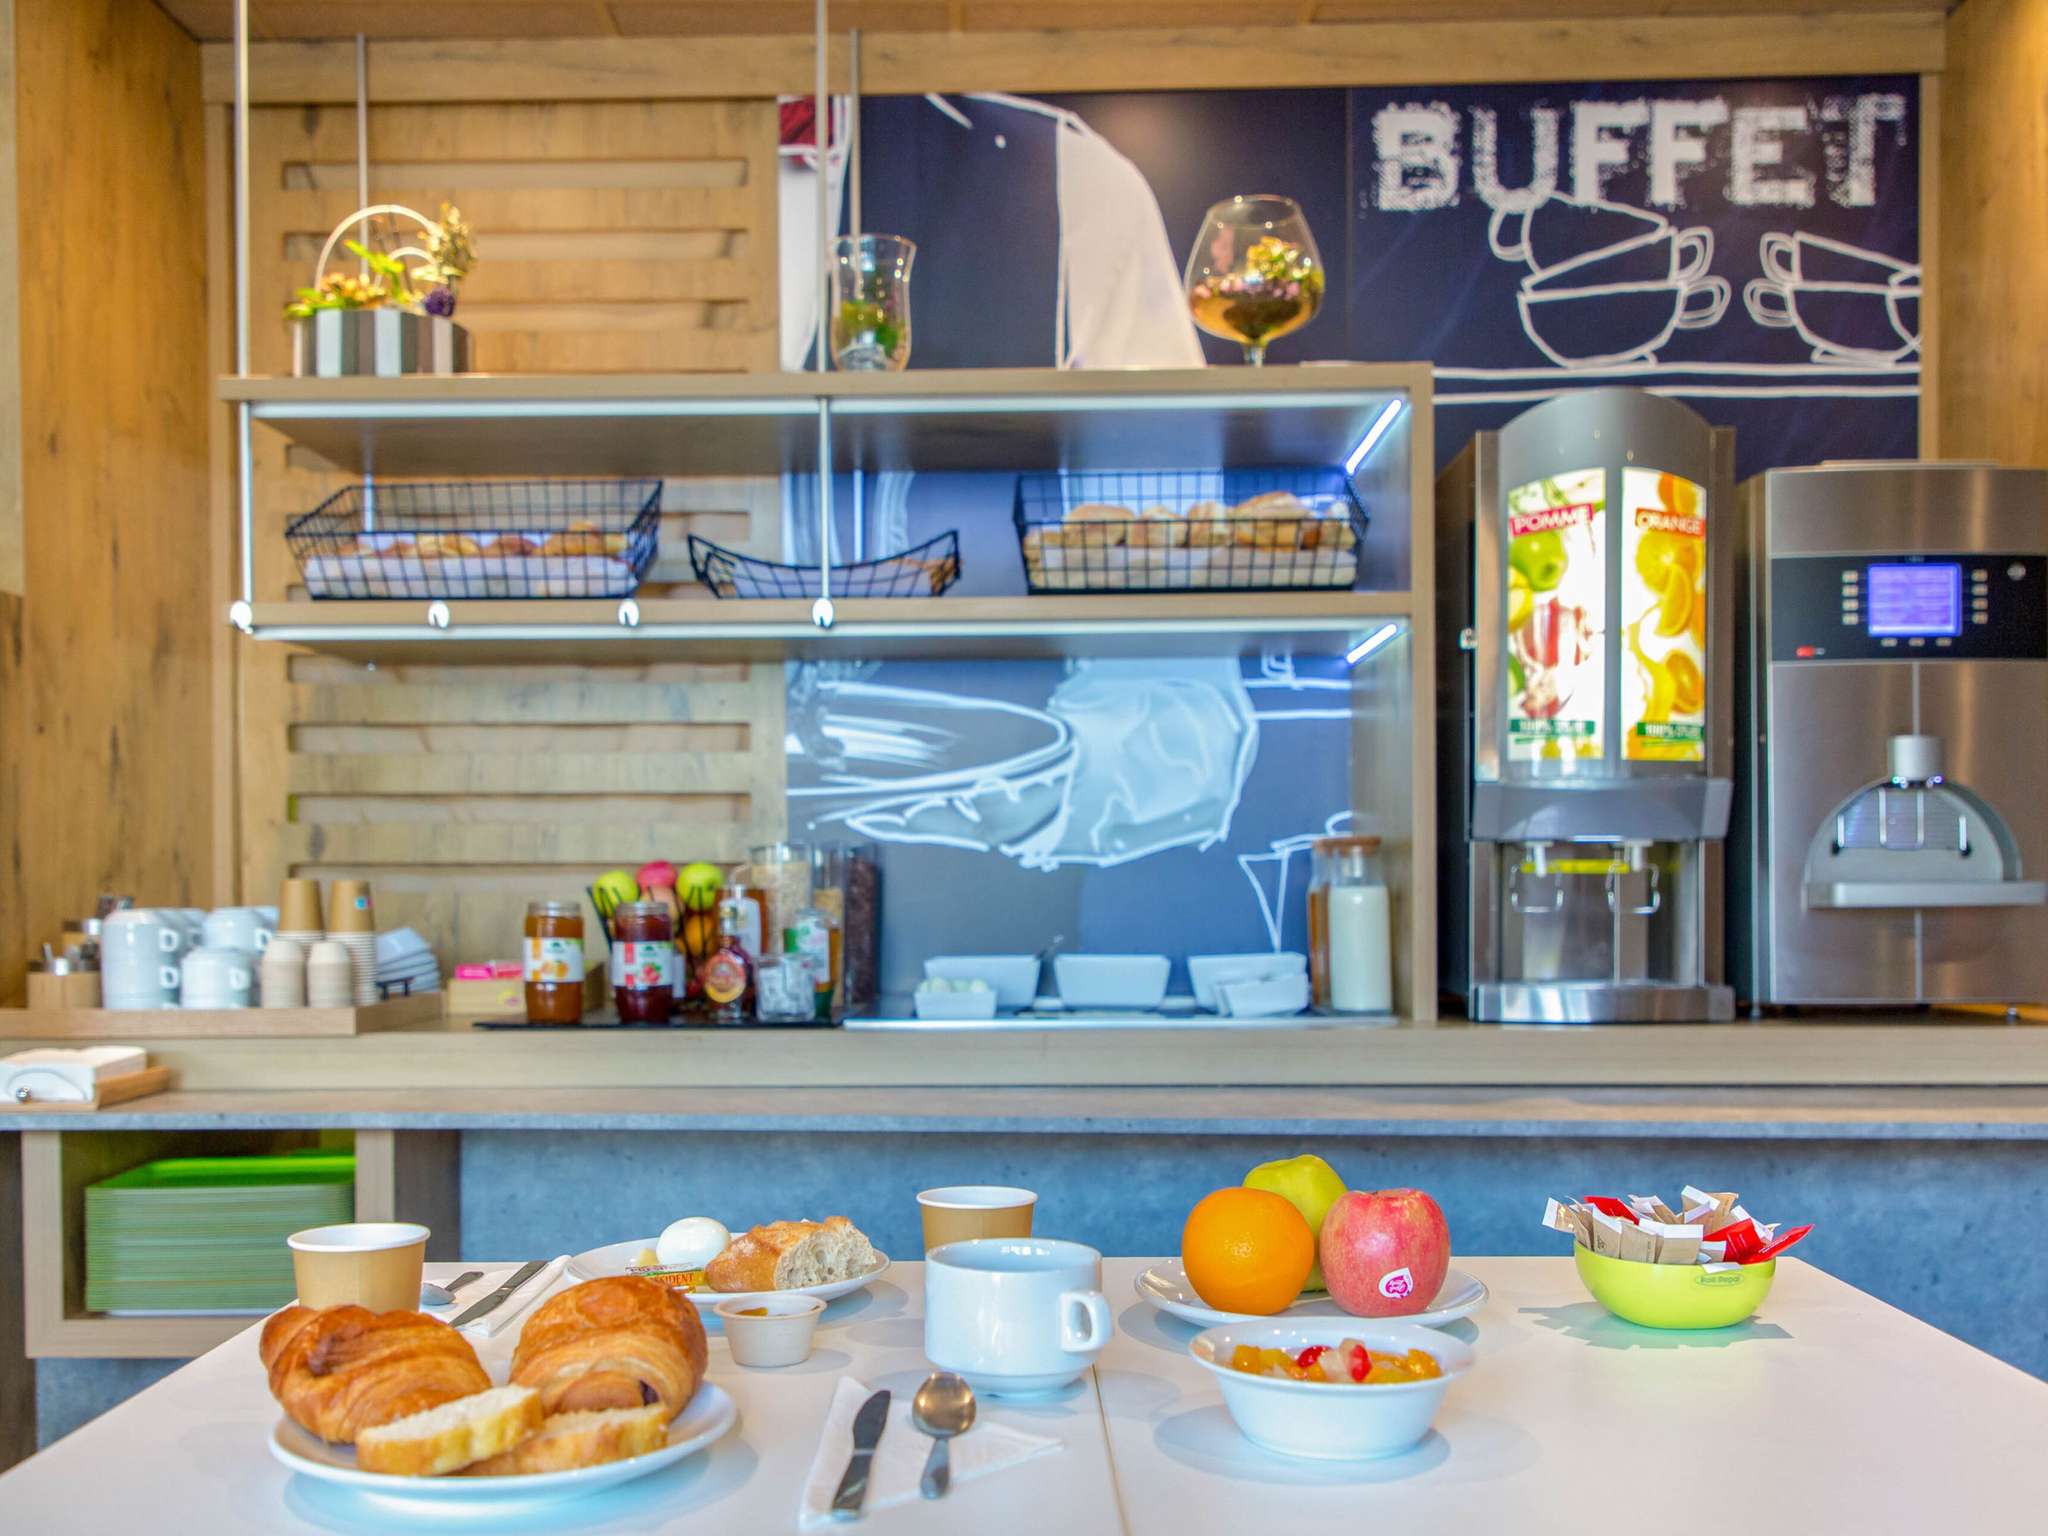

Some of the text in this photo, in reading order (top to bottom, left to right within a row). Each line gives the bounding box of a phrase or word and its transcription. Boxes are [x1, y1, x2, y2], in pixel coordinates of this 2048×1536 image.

[1372, 94, 1907, 211] BUFFET
[1512, 506, 1590, 533] POMME
[1636, 511, 1702, 536] ORANGE
